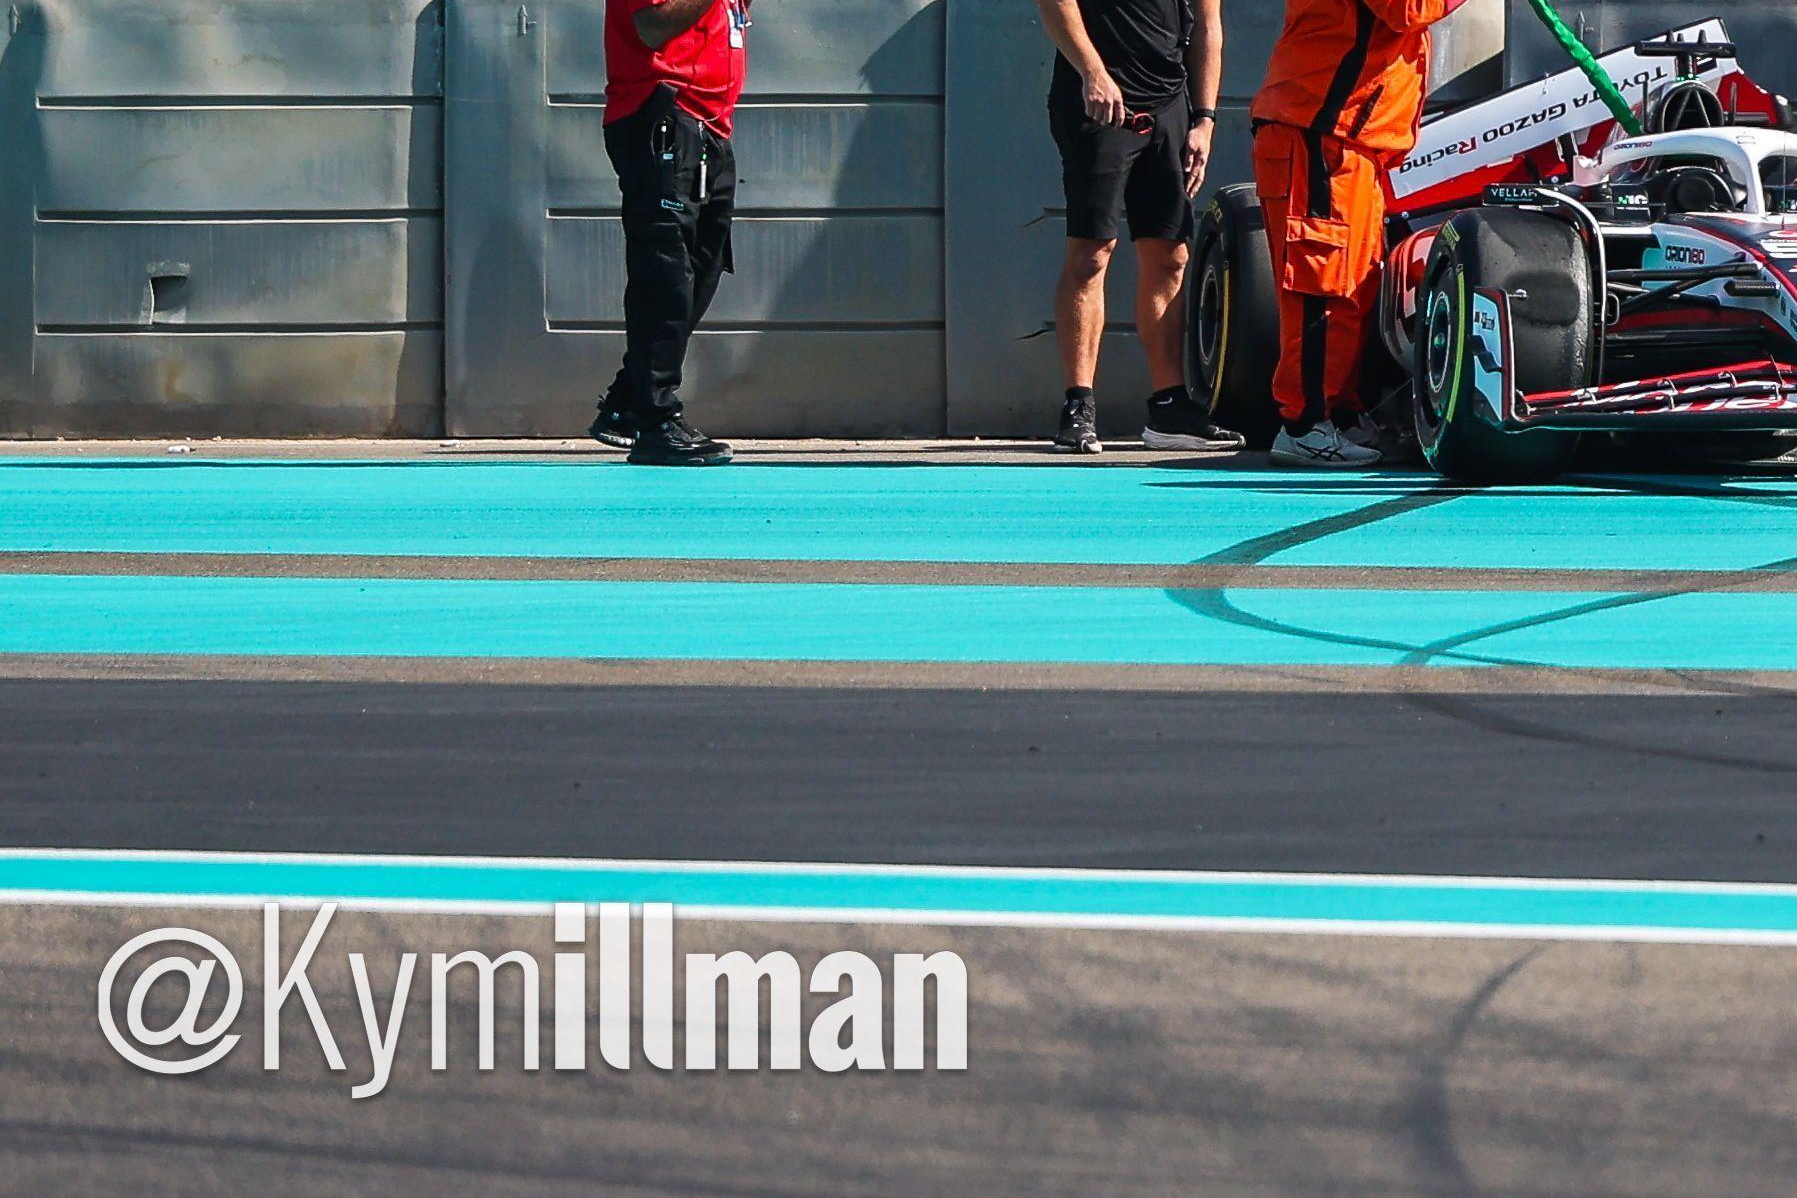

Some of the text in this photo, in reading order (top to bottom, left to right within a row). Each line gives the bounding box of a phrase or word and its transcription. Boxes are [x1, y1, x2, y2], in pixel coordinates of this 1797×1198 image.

[1398, 65, 1668, 174] TOYTA GAZOO Racing
